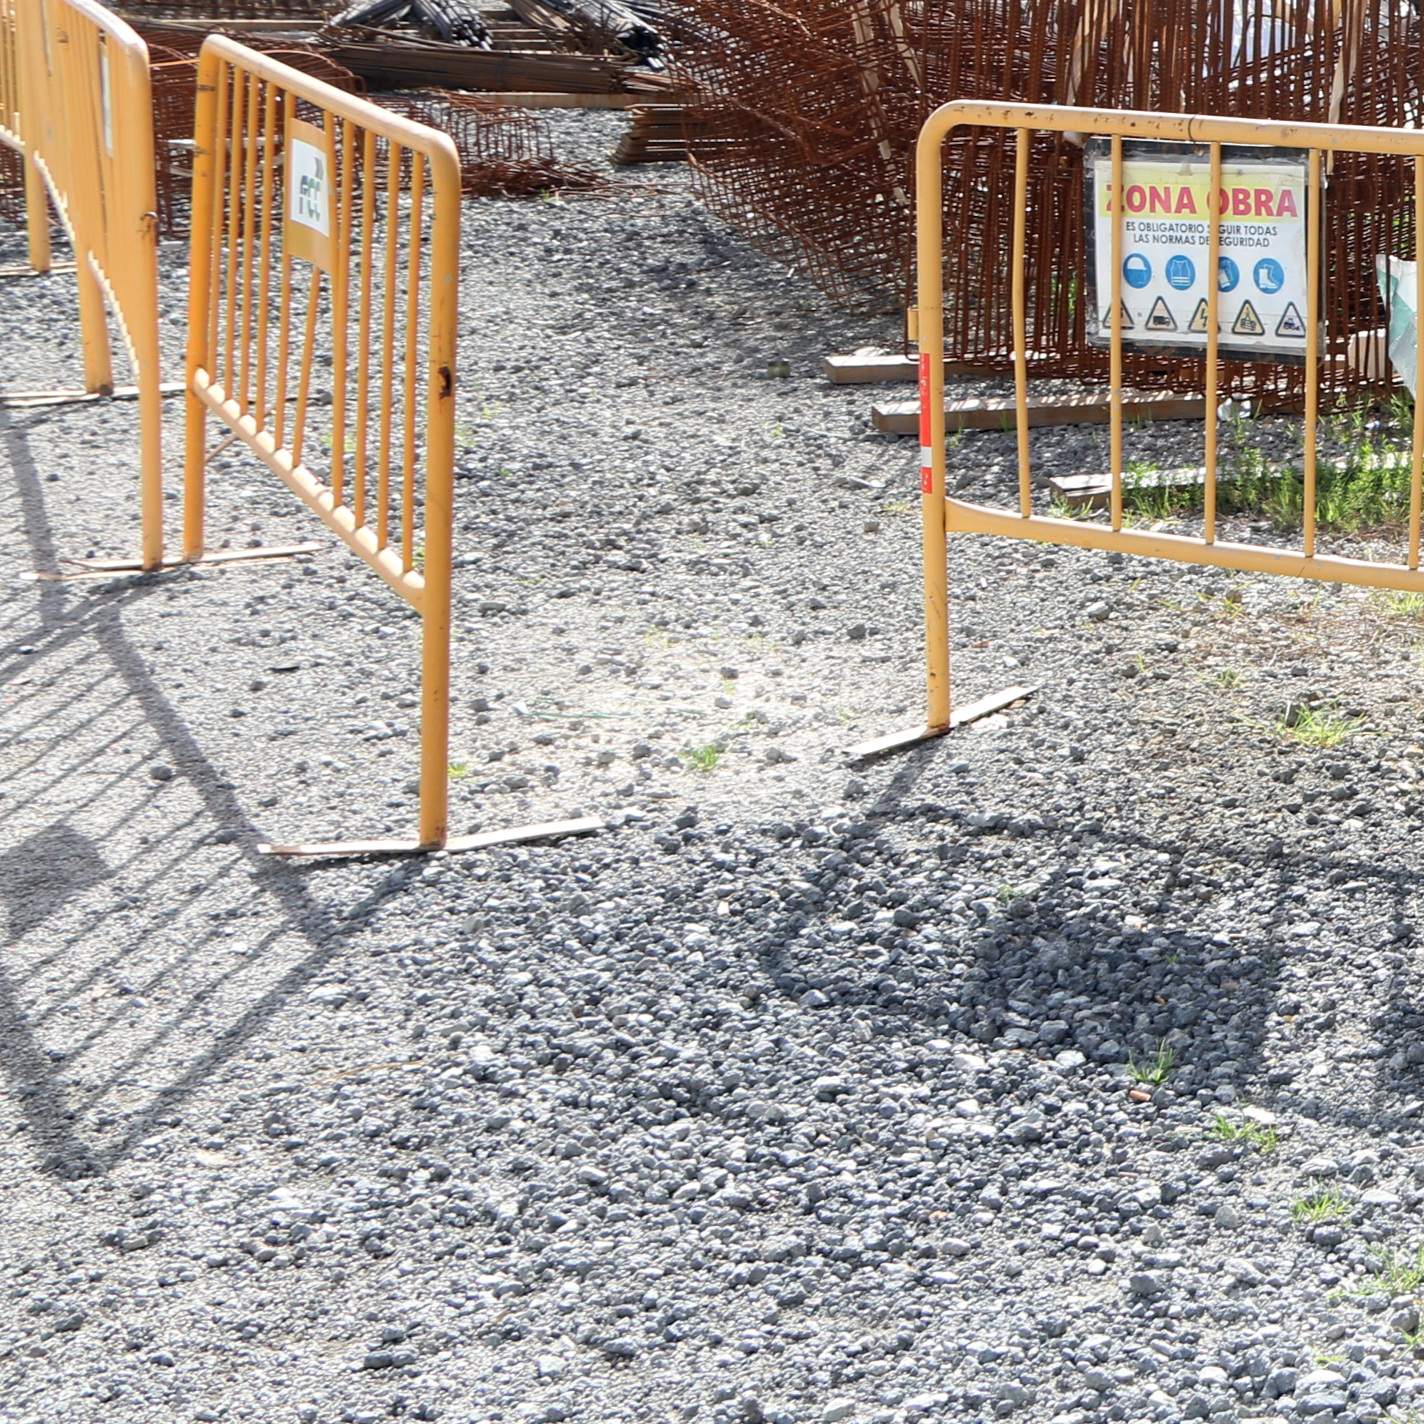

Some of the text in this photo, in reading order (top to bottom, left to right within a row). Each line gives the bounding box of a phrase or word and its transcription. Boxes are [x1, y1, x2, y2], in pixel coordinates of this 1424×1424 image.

[1207, 187, 1298, 217] OBRA
[1126, 222, 1277, 236] ES OBLIGATORIO GUIR TODAS
[1134, 233, 1150, 243] LAS
[1152, 235, 1196, 245] NORMAS
[1218, 236, 1270, 247] EGURIDAD
